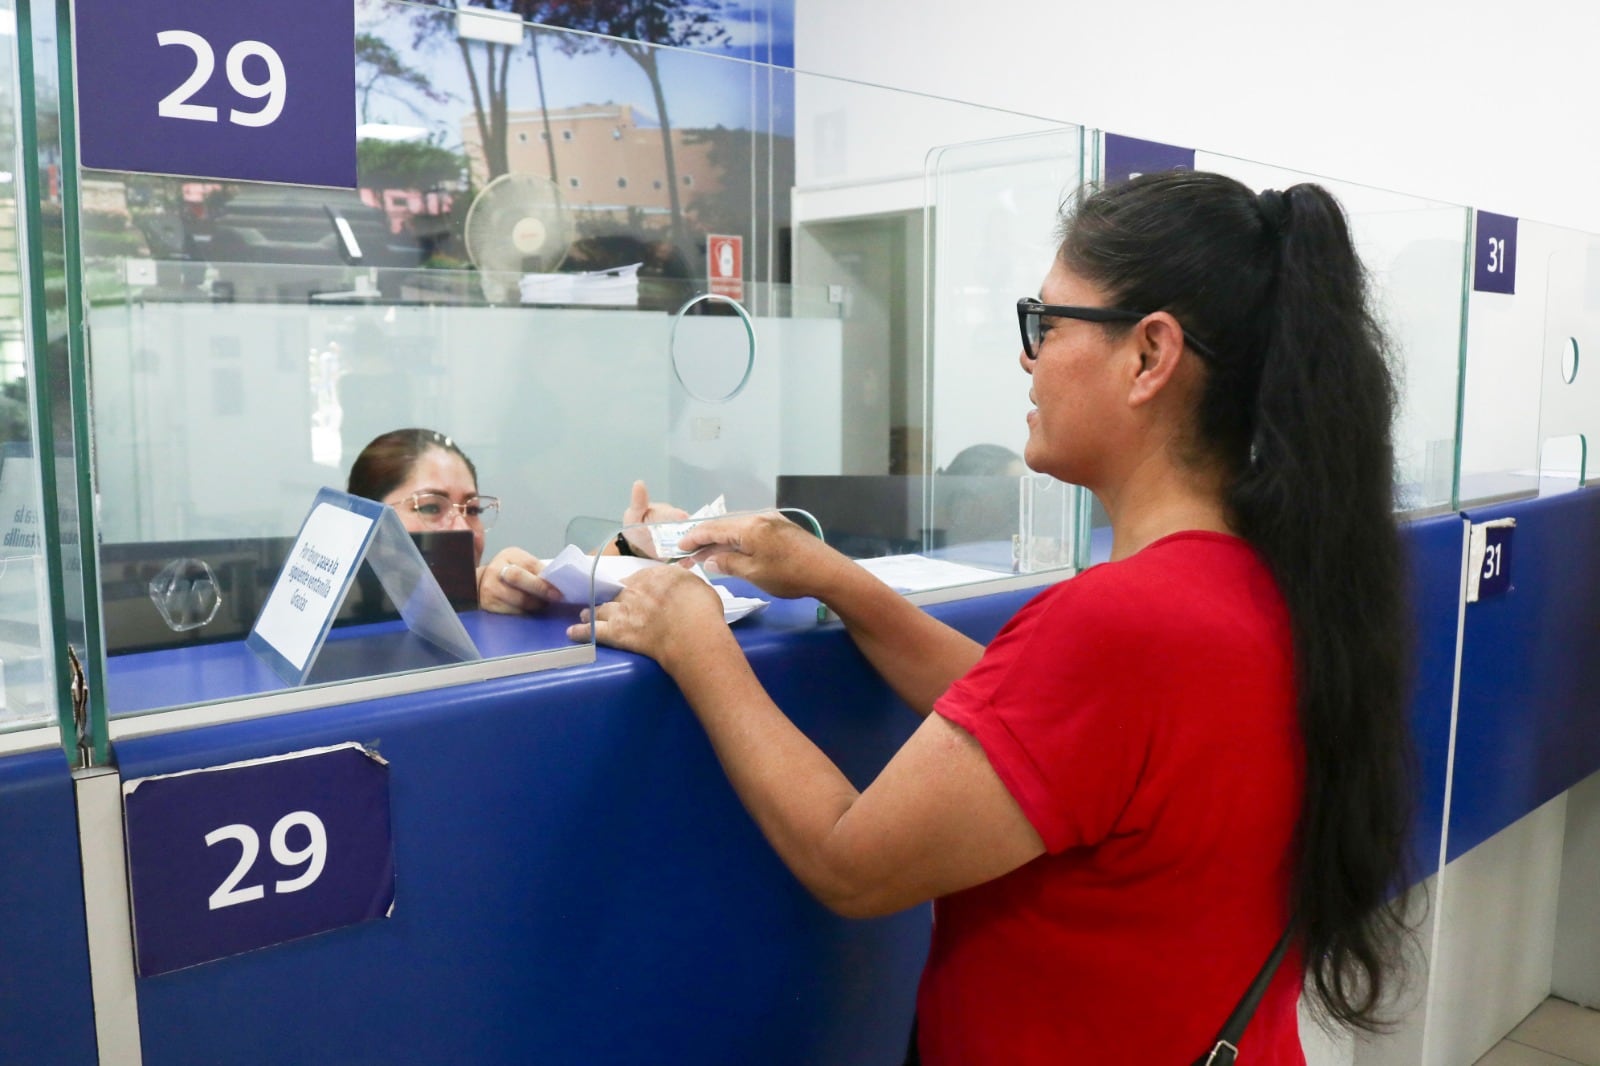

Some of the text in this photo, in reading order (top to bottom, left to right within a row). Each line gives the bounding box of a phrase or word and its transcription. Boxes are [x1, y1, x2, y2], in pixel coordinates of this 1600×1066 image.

[157, 30, 286, 127] 29
[1487, 237, 1505, 273] 31
[314, 555, 330, 571] pase
[331, 557, 339, 575] la
[1484, 543, 1502, 579] 31
[288, 562, 331, 598] siguiente ventanilla
[290, 588, 308, 611] Gracias
[205, 811, 327, 910] 29
